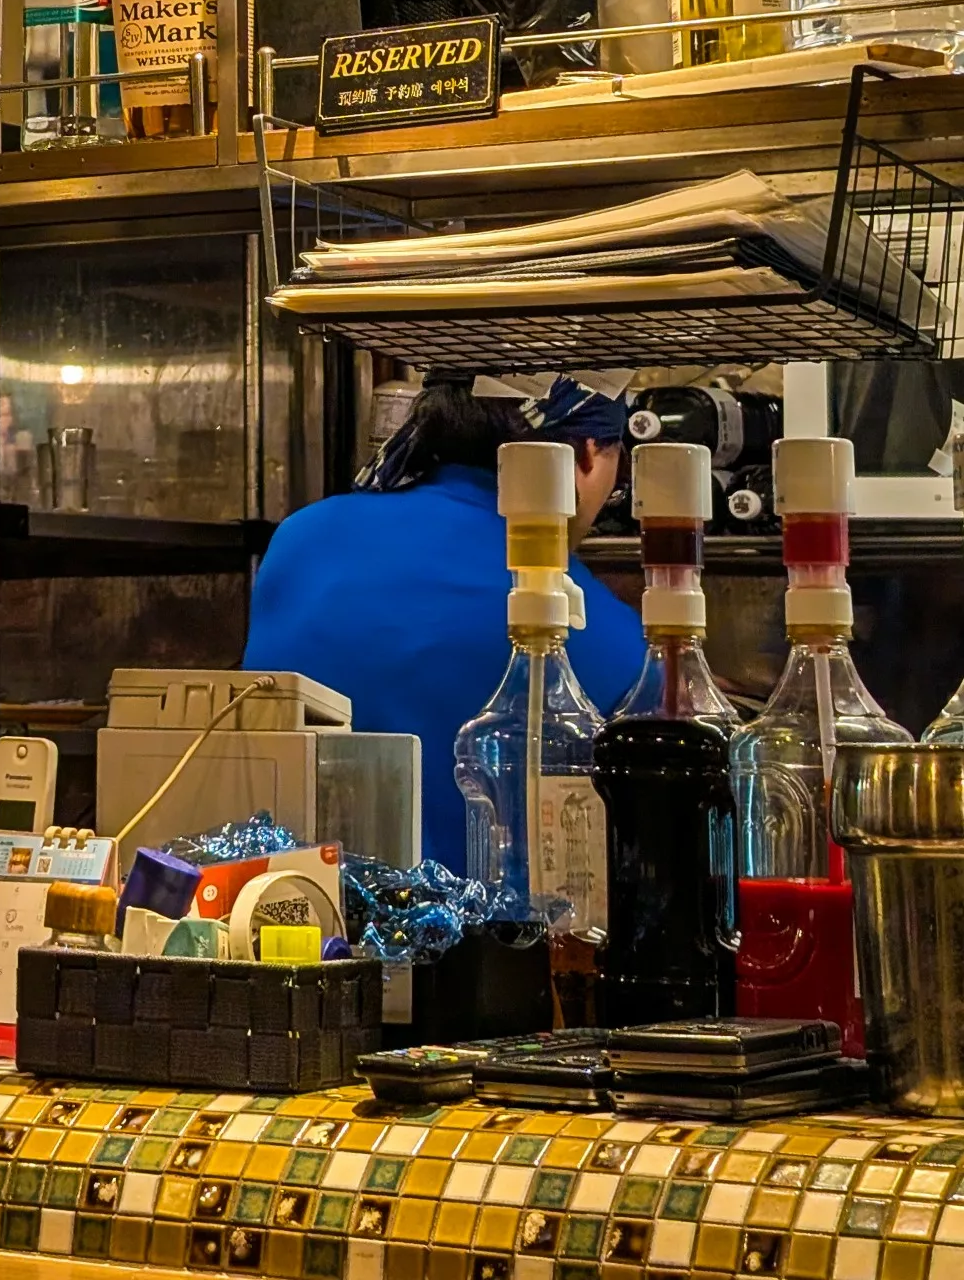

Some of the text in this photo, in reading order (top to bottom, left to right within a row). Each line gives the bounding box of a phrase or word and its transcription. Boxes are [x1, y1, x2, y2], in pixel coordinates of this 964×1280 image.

[143, 21, 218, 45] Mark
[330, 37, 483, 79] RESERVED
[430, 76, 469, 96] 예약석
